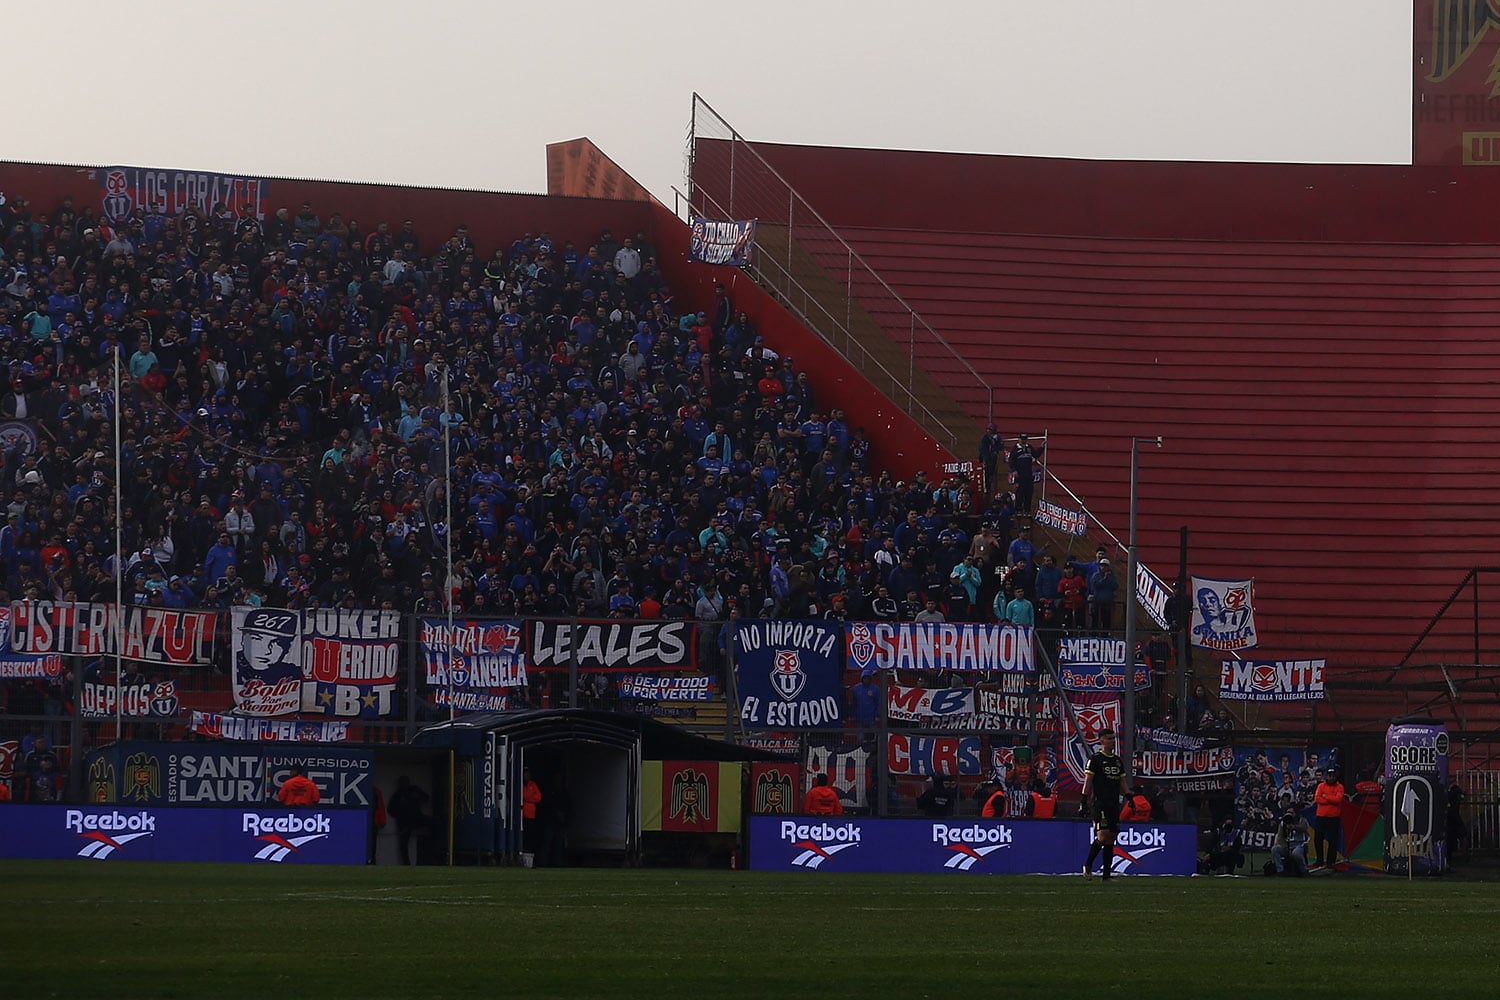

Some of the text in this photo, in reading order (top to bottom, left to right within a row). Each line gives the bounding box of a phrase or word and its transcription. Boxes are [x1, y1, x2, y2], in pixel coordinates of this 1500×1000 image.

[136, 170, 167, 214] LOS
[254, 613, 292, 630] 267
[302, 608, 400, 639] JOKER
[533, 620, 685, 667] LEALES
[739, 620, 837, 658] NO IMPORTA
[876, 622, 1035, 671] SAN RAMON
[1068, 639, 1126, 663] MERINO
[302, 638, 400, 683] QUERIDO
[635, 676, 709, 689] DEJO TODO
[661, 687, 708, 700] VERTE
[742, 695, 839, 727] EL ESTADIO
[273, 757, 370, 769] UNIVERSIDAD
[888, 733, 980, 775] CHRS
[1142, 747, 1219, 776] QUILPUE
[1391, 746, 1436, 764] SCORE
[168, 755, 177, 803] ESTADIO
[483, 741, 493, 818] ESTADIO
[1176, 779, 1222, 792] FORESTAL
[67, 810, 155, 833] Reebok
[242, 813, 331, 836] Reebok
[781, 821, 861, 844] Reebok
[932, 823, 1012, 846] Reebok
